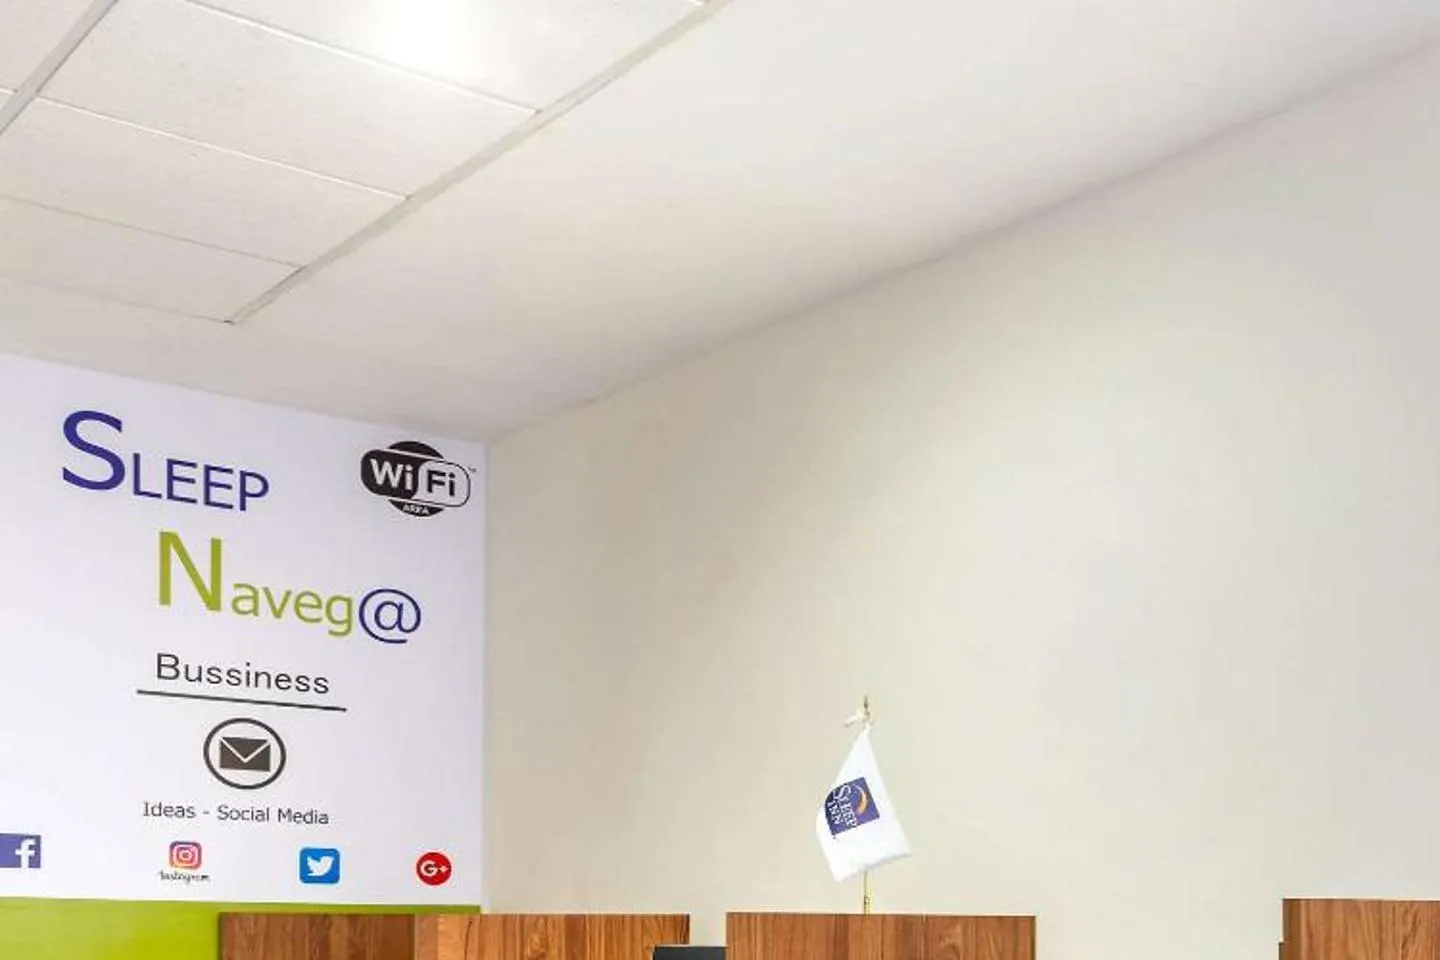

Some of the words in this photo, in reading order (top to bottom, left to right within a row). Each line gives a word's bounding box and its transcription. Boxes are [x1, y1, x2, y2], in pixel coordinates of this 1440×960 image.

[62, 410, 270, 511] SLEEP
[158, 530, 422, 643] Naveg@
[156, 652, 330, 694] Bussiness
[142, 802, 197, 819] Ideas
[217, 804, 270, 822] Social
[277, 808, 330, 825] Media
